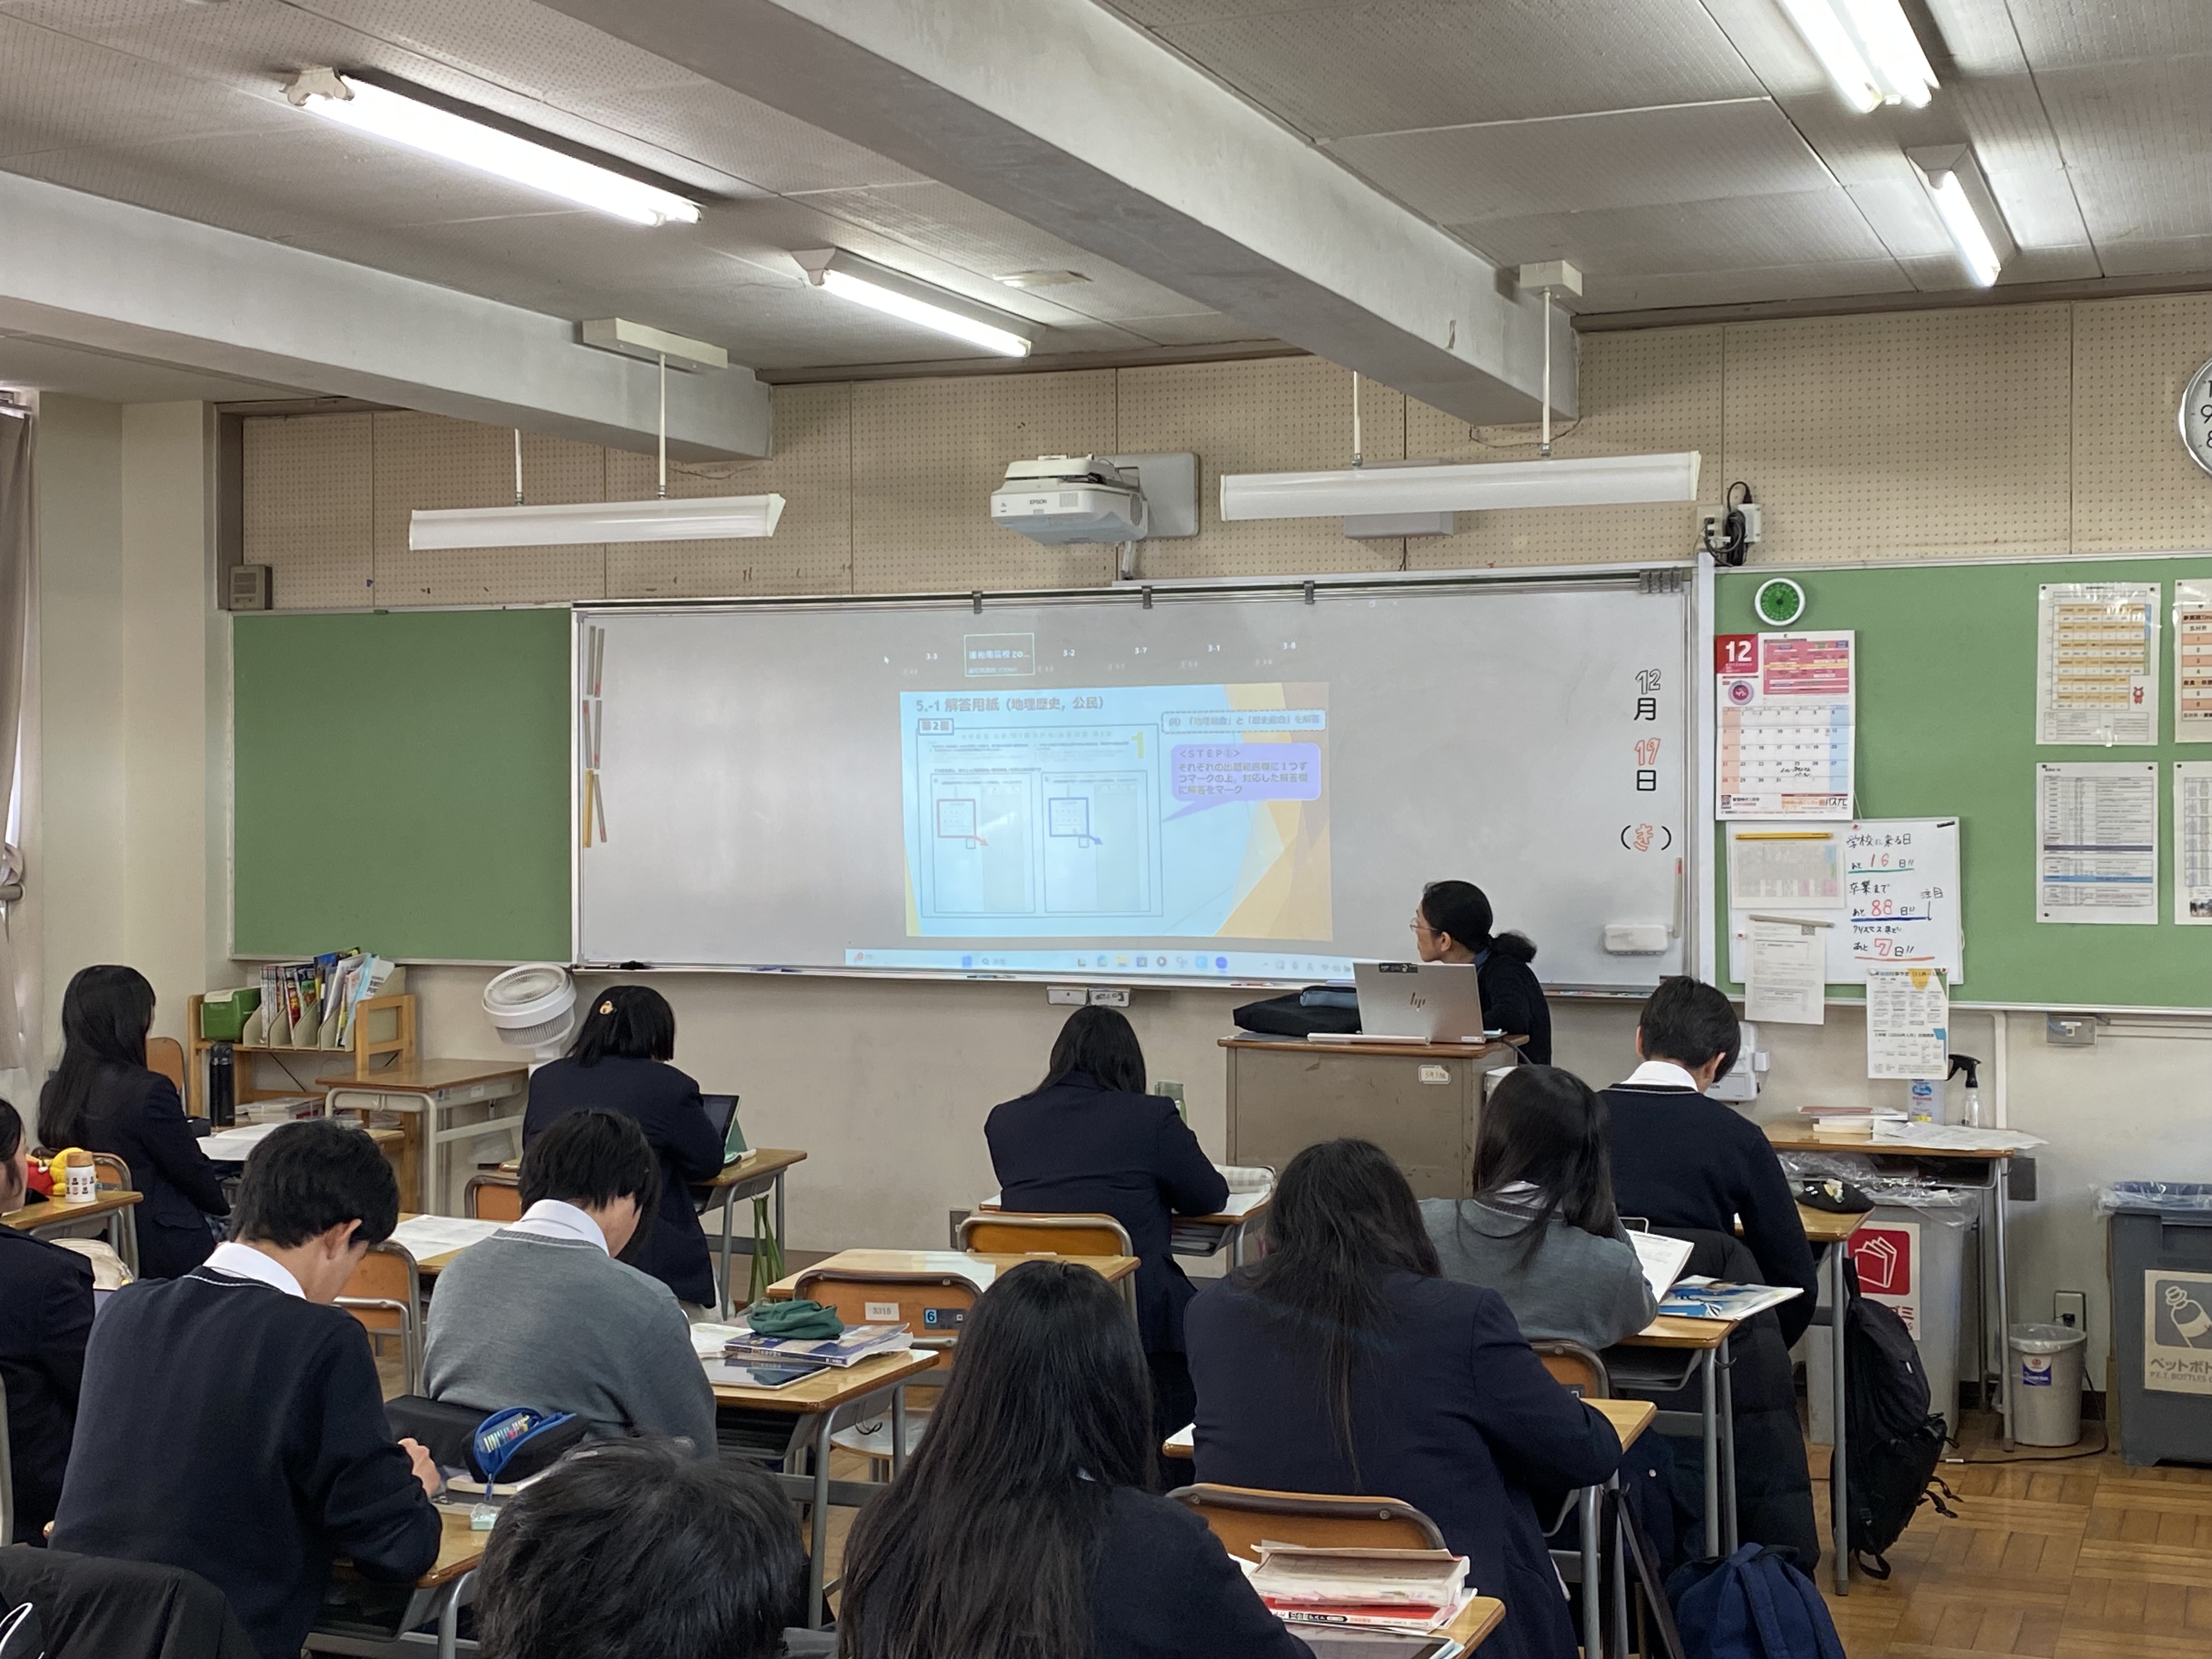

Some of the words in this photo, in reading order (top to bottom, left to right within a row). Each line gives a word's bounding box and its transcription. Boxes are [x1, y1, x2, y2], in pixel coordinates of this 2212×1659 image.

[1725, 640, 1752, 662] 12
[1635, 669, 1661, 695] 12
[1634, 698, 1656, 721] 月
[1130, 731, 1146, 759] 1
[1634, 737, 1661, 766] 19
[1637, 770, 1656, 791] 日
[1847, 833, 1911, 849] 学校に来る日
[1849, 880, 1891, 895] 卒業まで
[1852, 908, 1865, 917] あと
[1871, 899, 1893, 917] 88
[1853, 941, 1868, 951] あと
[1874, 938, 1893, 956] 7
[1410, 992, 1426, 1008] hp
[927, 1311, 935, 1322] 6
